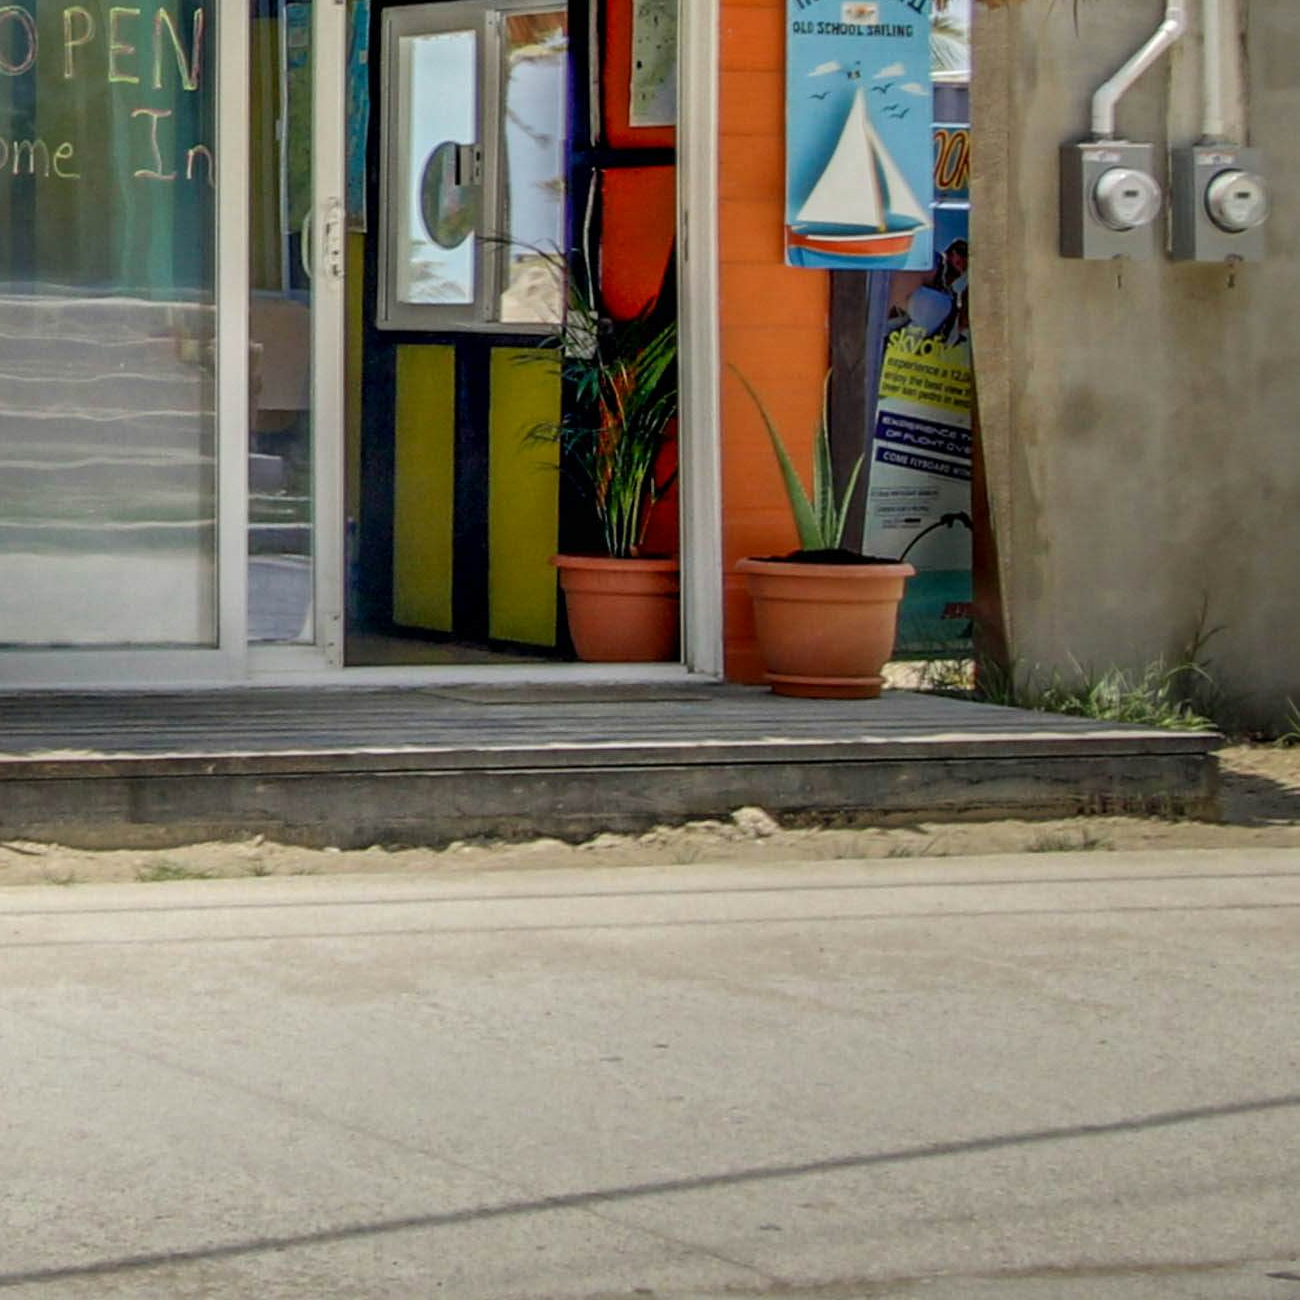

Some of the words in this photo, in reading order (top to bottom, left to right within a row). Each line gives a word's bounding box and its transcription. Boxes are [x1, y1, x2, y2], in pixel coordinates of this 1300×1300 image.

[792, 21, 813, 35] OLD
[817, 21, 864, 36] SCHOOL
[867, 24, 913, 37] SAILING
[131, 108, 216, 189] In
[881, 416, 958, 440] EXPERIENCE
[885, 428, 903, 438] OF
[903, 433, 945, 449] FLIGHT
[882, 451, 909, 465] COME
[909, 456, 952, 474] FLYBOARD
